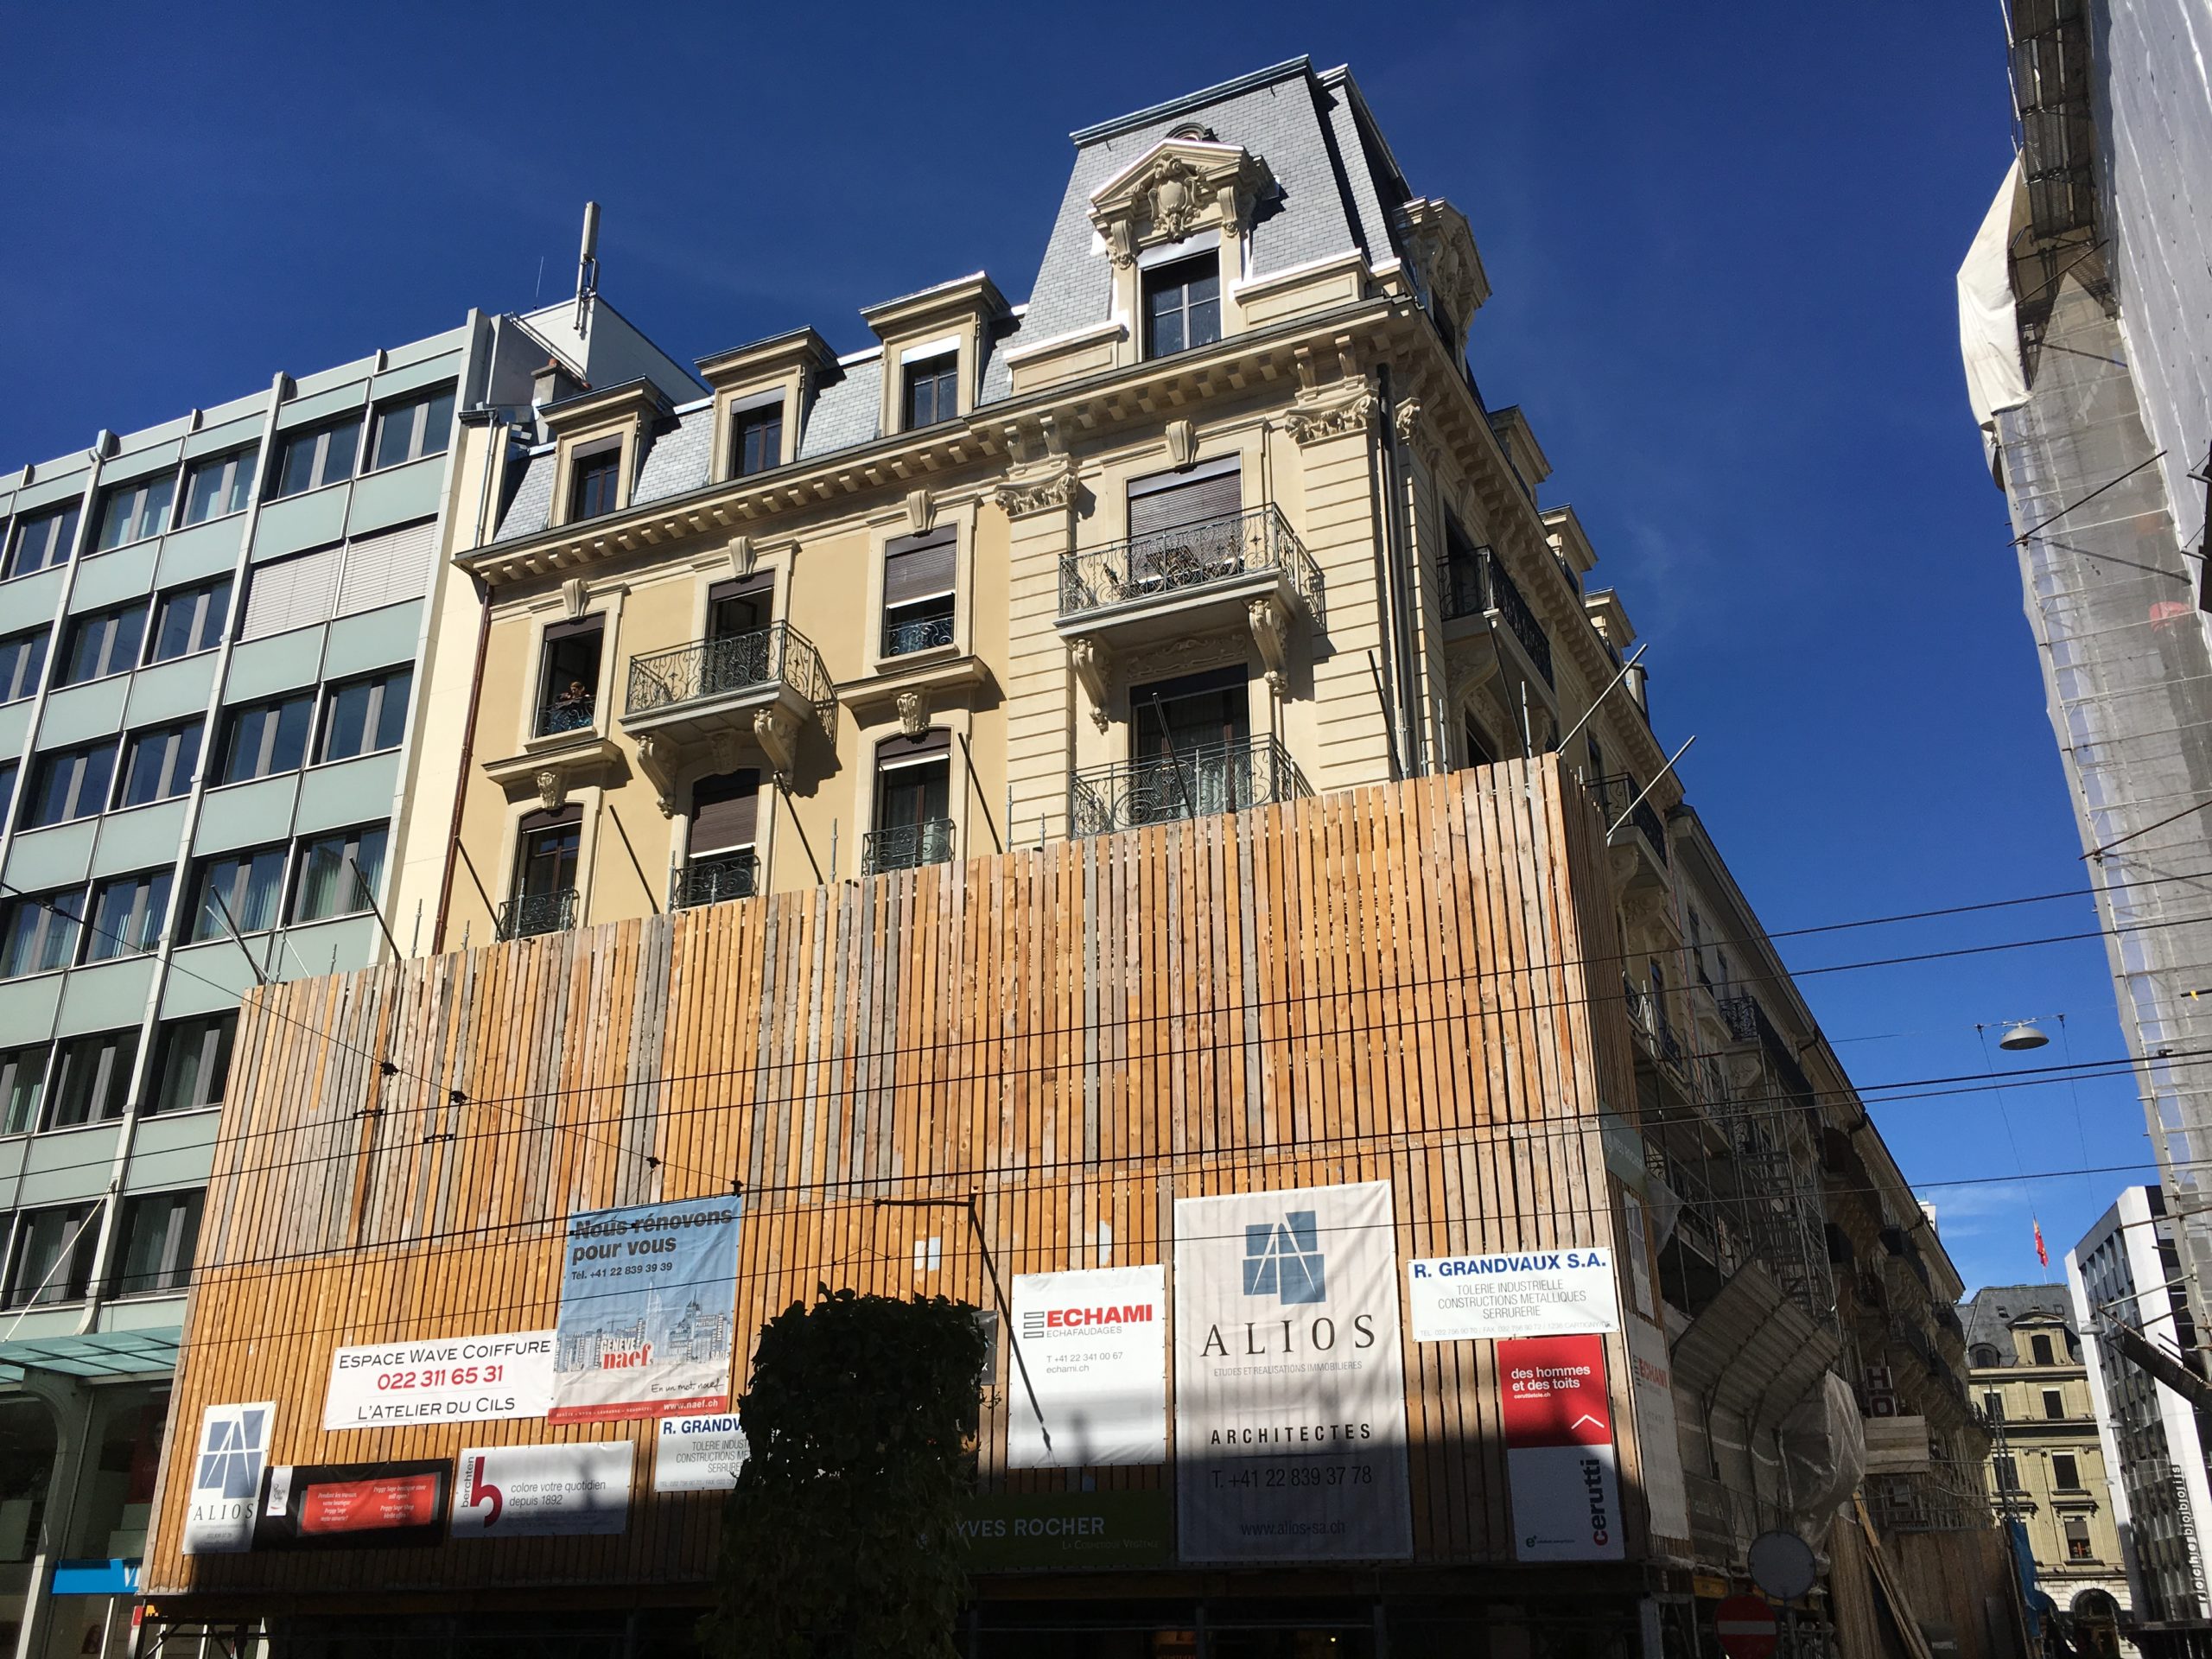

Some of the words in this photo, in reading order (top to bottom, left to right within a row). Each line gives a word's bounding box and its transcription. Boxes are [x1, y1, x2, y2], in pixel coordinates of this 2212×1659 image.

[575, 1218, 627, 1239] Nous
[634, 1209, 733, 1233] rénovons
[572, 1242, 621, 1265] pour
[627, 1236, 677, 1255] vous
[571, 1270, 588, 1280] Tél.
[589, 1268, 607, 1278] +41
[610, 1267, 622, 1276] 22
[625, 1265, 643, 1274] 839
[645, 1263, 658, 1273] 39
[660, 1262, 673, 1271] 39
[1414, 1263, 1432, 1278] R.
[1439, 1255, 1561, 1276] GRANDVAUX
[1567, 1252, 1607, 1268] S.A.
[1457, 1283, 1496, 1295] TOLERIE
[1497, 1279, 1563, 1293] INDUSTRIELLE
[1438, 1294, 1518, 1309] CONSTRUCTIONS
[1520, 1291, 1586, 1304] METALLIQUES
[1046, 1304, 1153, 1328] ECHAMI
[1483, 1306, 1541, 1319] SERRURERIE
[1046, 1326, 1122, 1338] ECHAFAUDAGES
[1199, 1314, 1376, 1357] ALIOS
[339, 1352, 404, 1369] ESPACE
[410, 1348, 458, 1363] WAVE
[462, 1340, 551, 1359] COIFFURE
[603, 1343, 652, 1370] naef
[377, 1371, 416, 1390] 022
[420, 1369, 446, 1387] 311
[451, 1366, 478, 1385] 65
[483, 1364, 504, 1382] 31
[1046, 1364, 1090, 1374] echami.ch
[1214, 1366, 1243, 1376] ETUDES
[1243, 1366, 1253, 1376] ET
[1254, 1363, 1306, 1375] REALISATIONS
[1307, 1361, 1363, 1371] IMMOBILIERES
[1510, 1368, 1534, 1380] des
[1536, 1365, 1591, 1377] hommes
[1512, 1381, 1524, 1391] et
[1527, 1379, 1550, 1390] des
[1553, 1376, 1580, 1389] toits
[358, 1402, 442, 1421] L'ATELIER
[446, 1401, 471, 1414] DU
[476, 1397, 516, 1413] CILS
[664, 1401, 719, 1410] www.naef.ch
[663, 1421, 676, 1434] R.
[681, 1417, 742, 1433] GRANDV
[1211, 1423, 1370, 1445] ARCHITECTES
[692, 1440, 721, 1451] TOLERIE
[721, 1439, 749, 1450] INDUST
[676, 1451, 735, 1463] CONSTRUCTIONS
[708, 1462, 743, 1473] SERRURE
[461, 1456, 474, 1508] berchten
[511, 1481, 538, 1493] colore
[540, 1481, 563, 1491] votre
[565, 1479, 606, 1493] quotidien
[1211, 1471, 1224, 1489] T.
[1229, 1470, 1259, 1488] +41
[1266, 1469, 1286, 1487] 22
[1291, 1467, 1321, 1486] 839
[1326, 1466, 1347, 1485] 37
[1351, 1465, 1372, 1484] 78
[509, 1495, 538, 1508] depuis
[541, 1495, 563, 1506] 1892
[1580, 1459, 1608, 1546] cerutti
[193, 1503, 254, 1522] ALIOS
[955, 1519, 1007, 1538] YVES
[1014, 1516, 1105, 1536] ROCHER
[1240, 1520, 1345, 1535] www.alios-sa.ch
